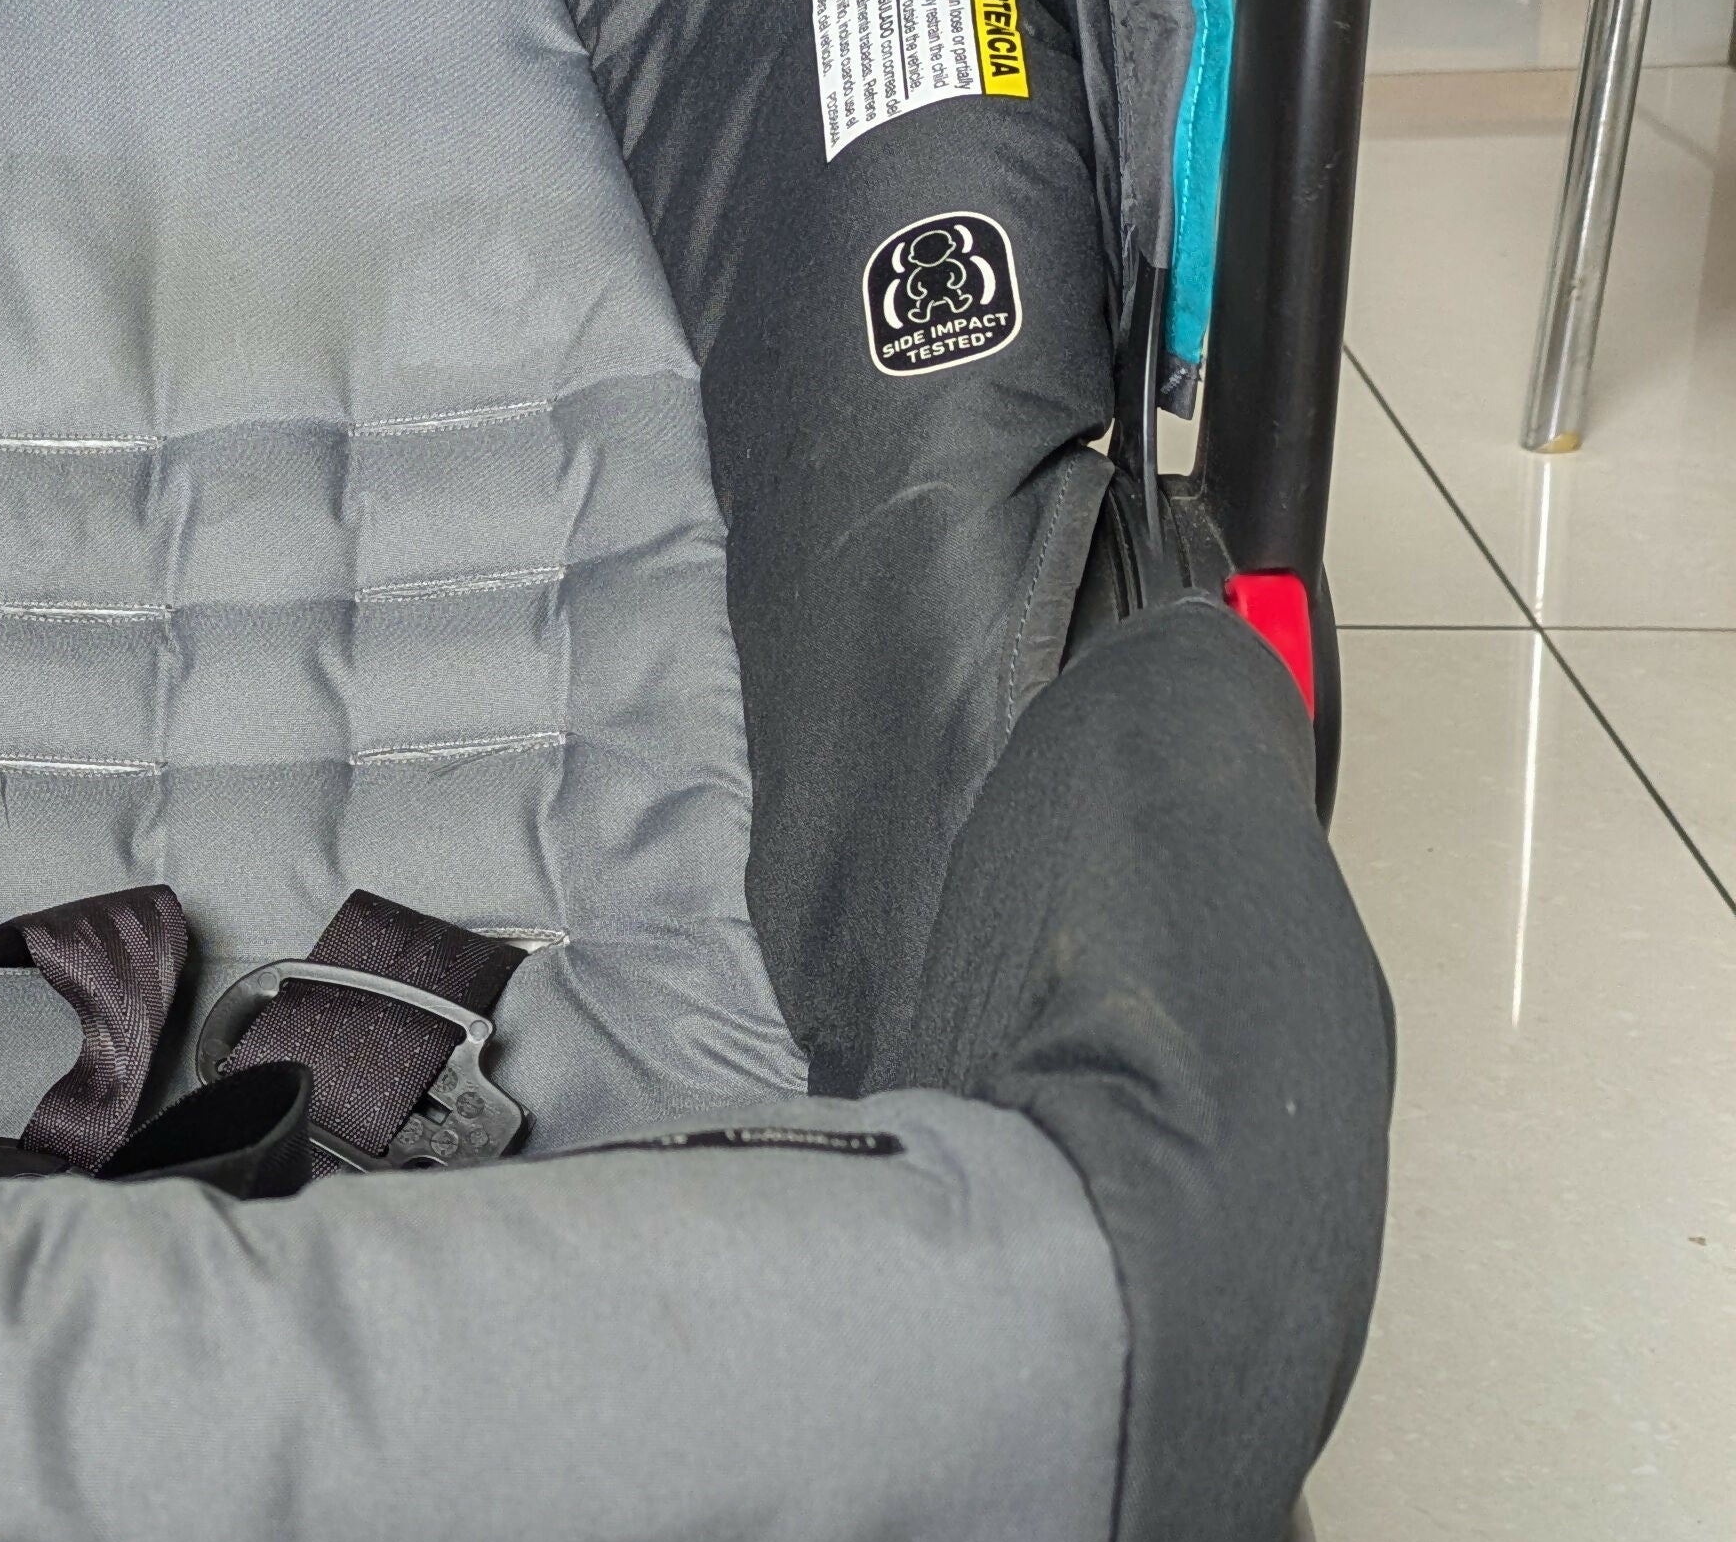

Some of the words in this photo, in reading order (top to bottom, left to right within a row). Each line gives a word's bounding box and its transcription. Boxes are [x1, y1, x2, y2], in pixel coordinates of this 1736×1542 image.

[817, 15, 831, 32] del
[903, 0, 919, 34] outside
[926, 8, 943, 43] restrain
[949, 8, 965, 33] loose
[820, 31, 834, 77] vehículo.
[837, 19, 852, 57] incluso
[880, 40, 893, 60] con
[904, 34, 920, 51] the
[929, 44, 945, 61] the
[953, 35, 965, 45] or
[859, 32, 875, 81] trabadas.
[906, 51, 925, 92] vehicle.
[950, 48, 974, 89] partially
[841, 57, 856, 97] cuando
[883, 59, 897, 99] correas
[932, 63, 950, 89] child
[863, 79, 878, 121] Refrene
[886, 99, 903, 117] del
[845, 117, 859, 130] el
[881, 330, 926, 358] SIDE
[931, 312, 1009, 339] IMPACT
